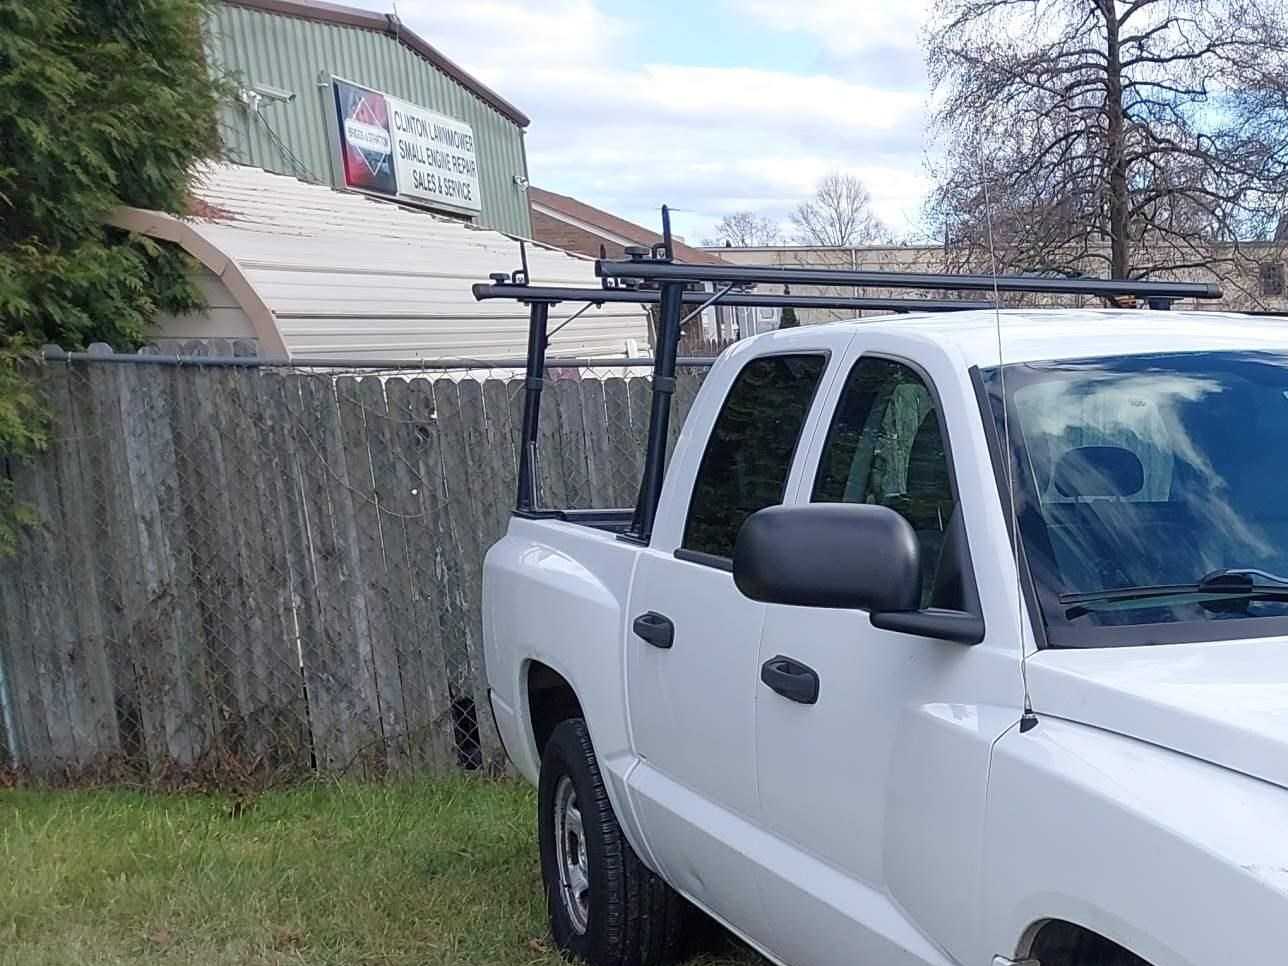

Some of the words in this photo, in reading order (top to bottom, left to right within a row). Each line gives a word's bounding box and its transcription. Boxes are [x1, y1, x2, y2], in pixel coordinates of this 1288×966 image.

[394, 111, 428, 139] CLINTON
[428, 121, 473, 152] LAWNMOWER
[399, 139, 426, 164] SMALL
[426, 147, 452, 172] ENGINE
[452, 155, 477, 177] REPAIR
[413, 169, 437, 193] SALES
[438, 176, 443, 194] &
[444, 178, 472, 201] SERVICE
